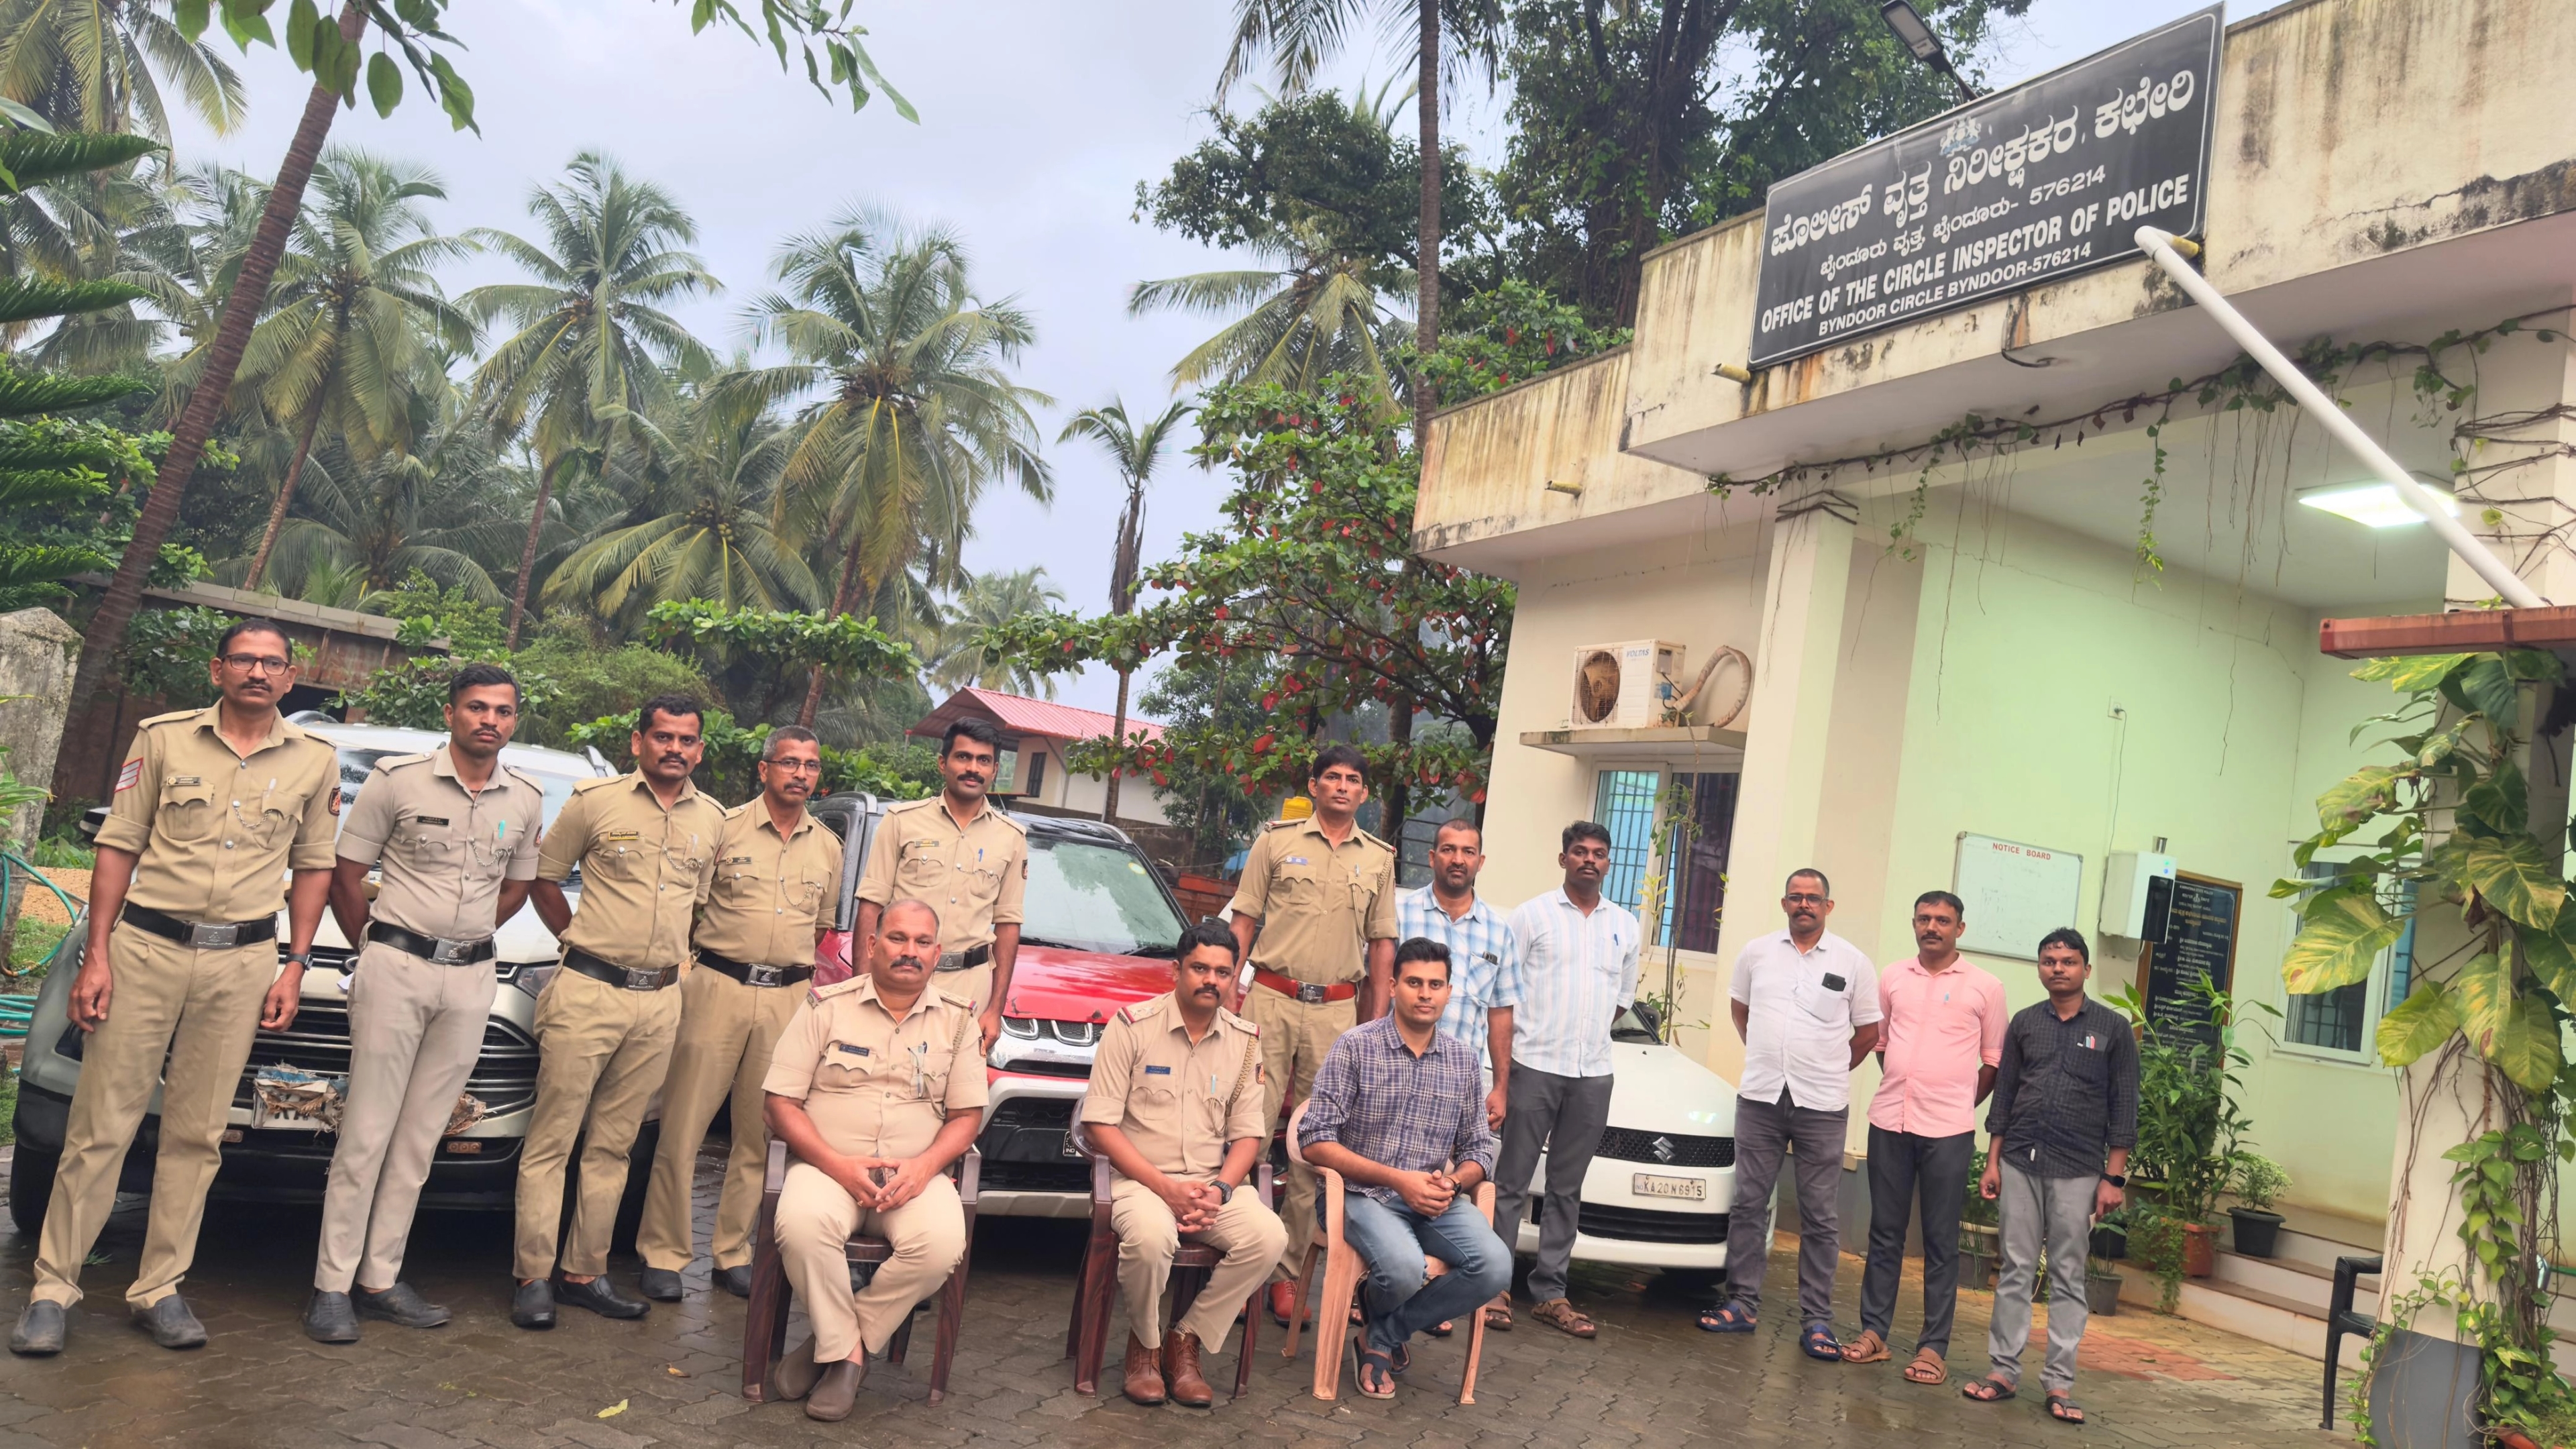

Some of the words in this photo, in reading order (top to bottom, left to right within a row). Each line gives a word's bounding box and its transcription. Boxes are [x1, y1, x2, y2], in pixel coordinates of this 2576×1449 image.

[1820, 238, 1887, 281] ಬೈಂದೂರು
[2029, 164, 2106, 205] 576214
[1884, 161, 1932, 229] ವೃತ್ತ
[1762, 294, 1814, 333] OFFICE
[1819, 286, 1841, 315] OF
[1845, 274, 1878, 306] THE
[1883, 252, 1946, 295] CIRCLE
[1952, 215, 2062, 274] INSPECTOR
[2070, 203, 2099, 237] OF
[2106, 174, 2189, 226] POLICE
[1819, 303, 1886, 336] BYNDOOR
[1890, 285, 1944, 315] CIRCLE
[1947, 241, 2091, 298] BYNDOOR-576214
[1626, 648, 1650, 657] VOLTAS
[1992, 842, 2021, 854] NOTICE
[2026, 849, 2051, 860] BOARD
